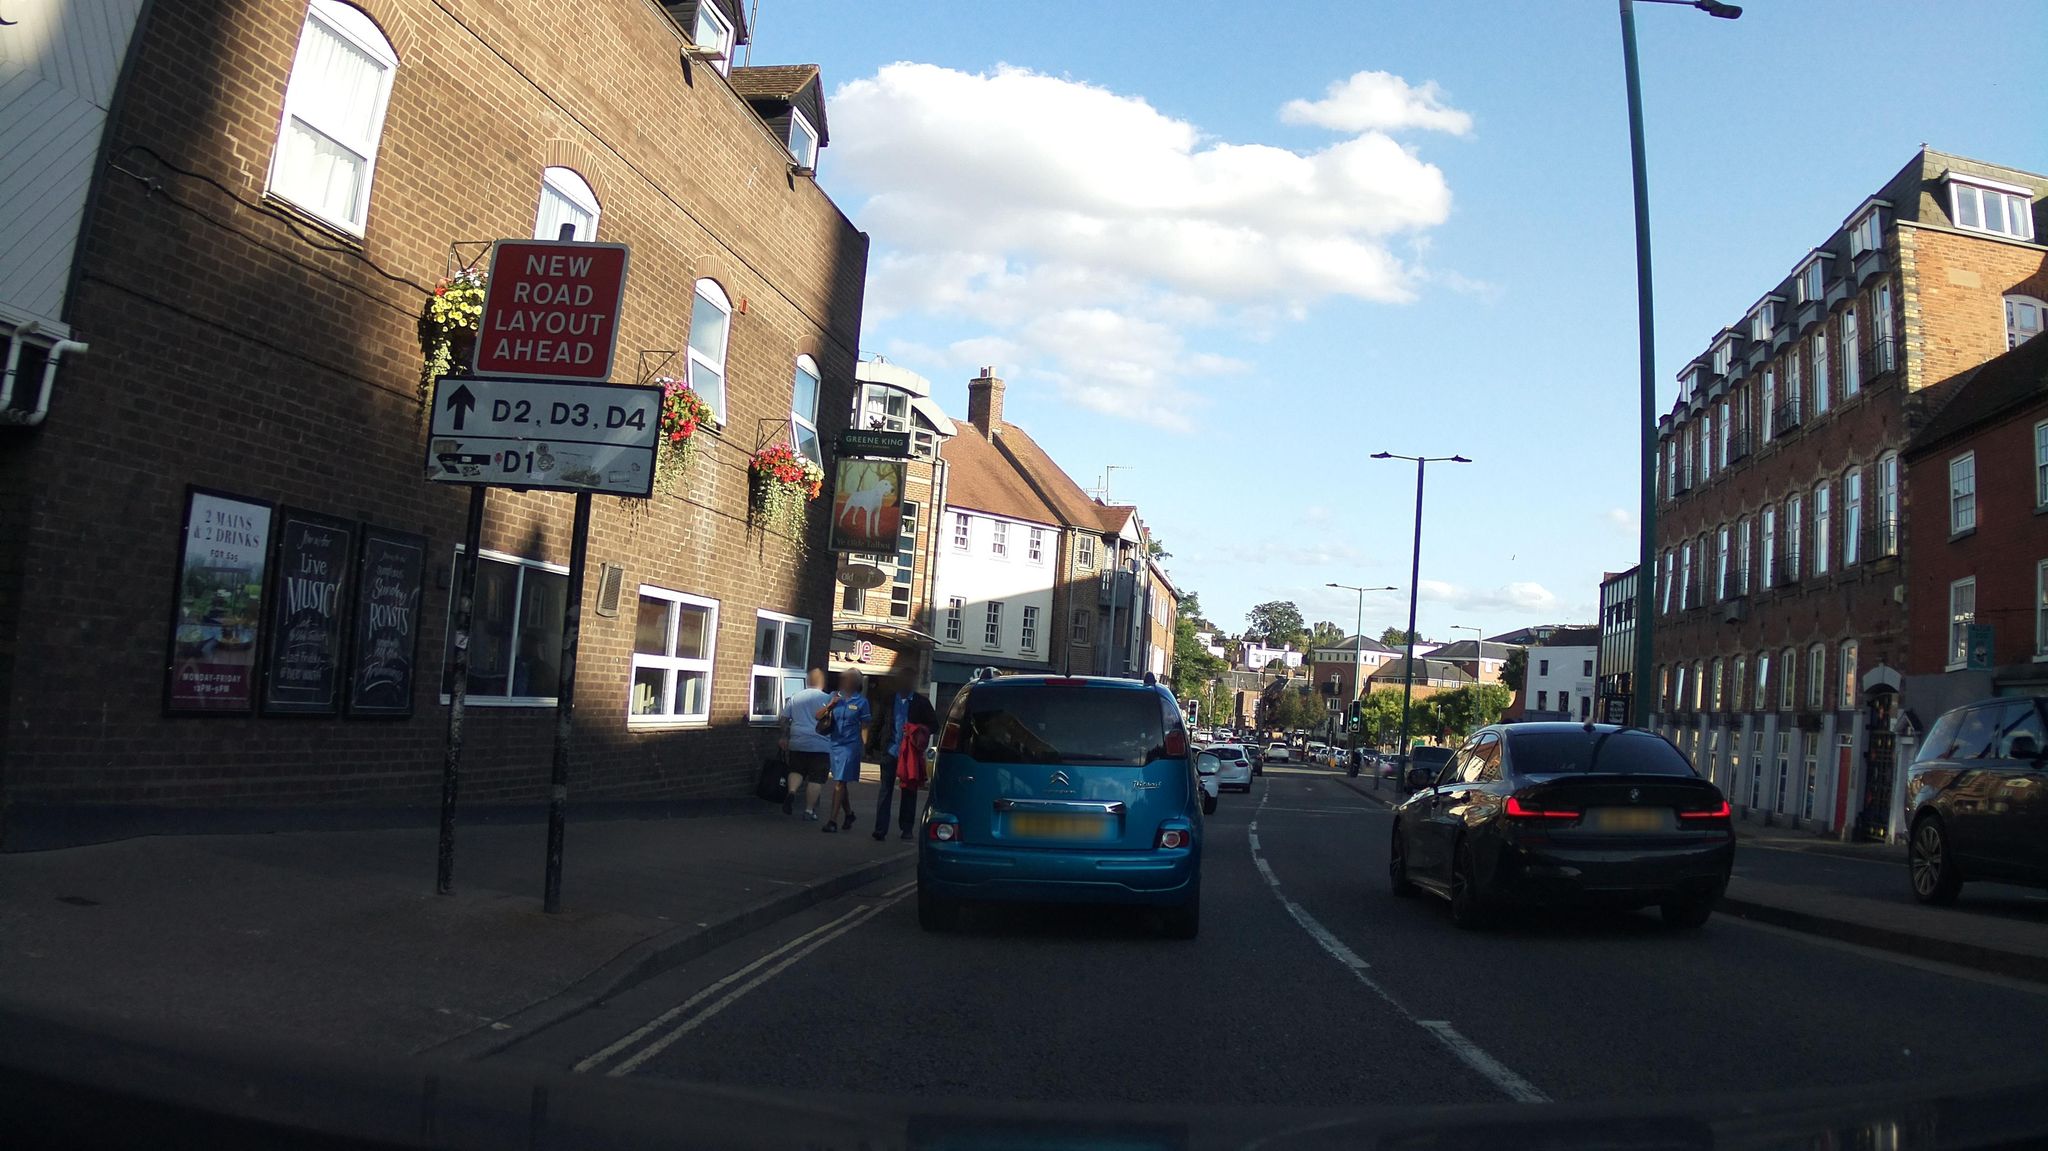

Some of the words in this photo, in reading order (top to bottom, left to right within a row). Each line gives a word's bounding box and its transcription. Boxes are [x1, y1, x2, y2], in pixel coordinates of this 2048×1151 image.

[525, 254, 593, 277] NEW
[513, 282, 593, 307] ROAD
[495, 309, 606, 336] LAYOUT
[493, 338, 594, 365] AHEAD
[491, 399, 541, 428] D2,
[550, 402, 599, 430] D3,
[606, 405, 646, 431] D4
[846, 435, 879, 445] GREENE
[882, 438, 904, 447] KING
[503, 450, 533, 474] D1
[205, 509, 213, 524] 2
[216, 511, 253, 531] MAINS
[193, 529, 201, 540] &
[205, 527, 213, 541] 2
[216, 528, 260, 548] DRINKS
[866, 540, 892, 549] Talbot
[210, 549, 224, 560] FOR
[301, 552, 328, 576] Live
[372, 577, 408, 606] Sunday
[368, 602, 409, 638] ROASTS
[182, 672, 241, 683] MONDAY-FRIDAY
